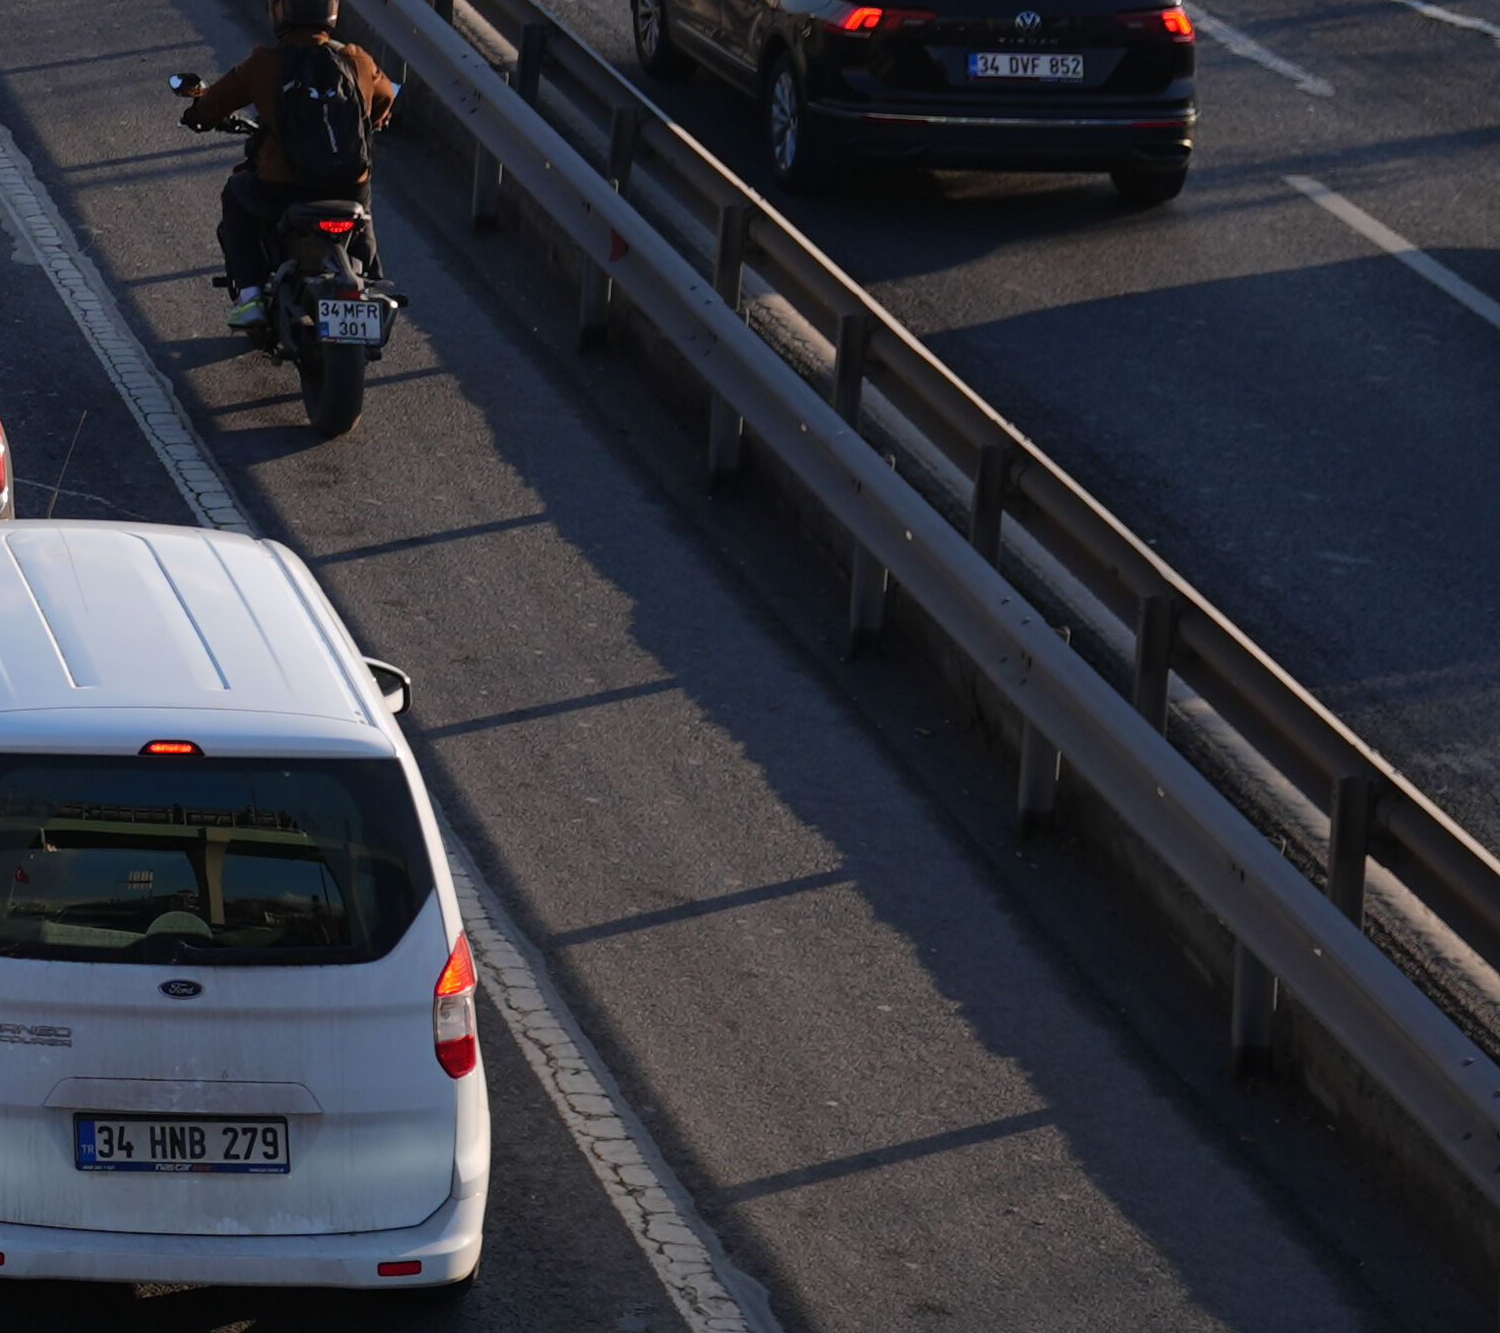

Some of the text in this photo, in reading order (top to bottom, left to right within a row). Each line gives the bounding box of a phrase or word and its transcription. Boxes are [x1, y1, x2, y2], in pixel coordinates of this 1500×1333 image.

[980, 56, 1082, 75] 34 DVF 852
[320, 302, 378, 320] 34 MFR
[339, 321, 367, 337] 301
[81, 1127, 282, 1161] TR 34 HNB 279
